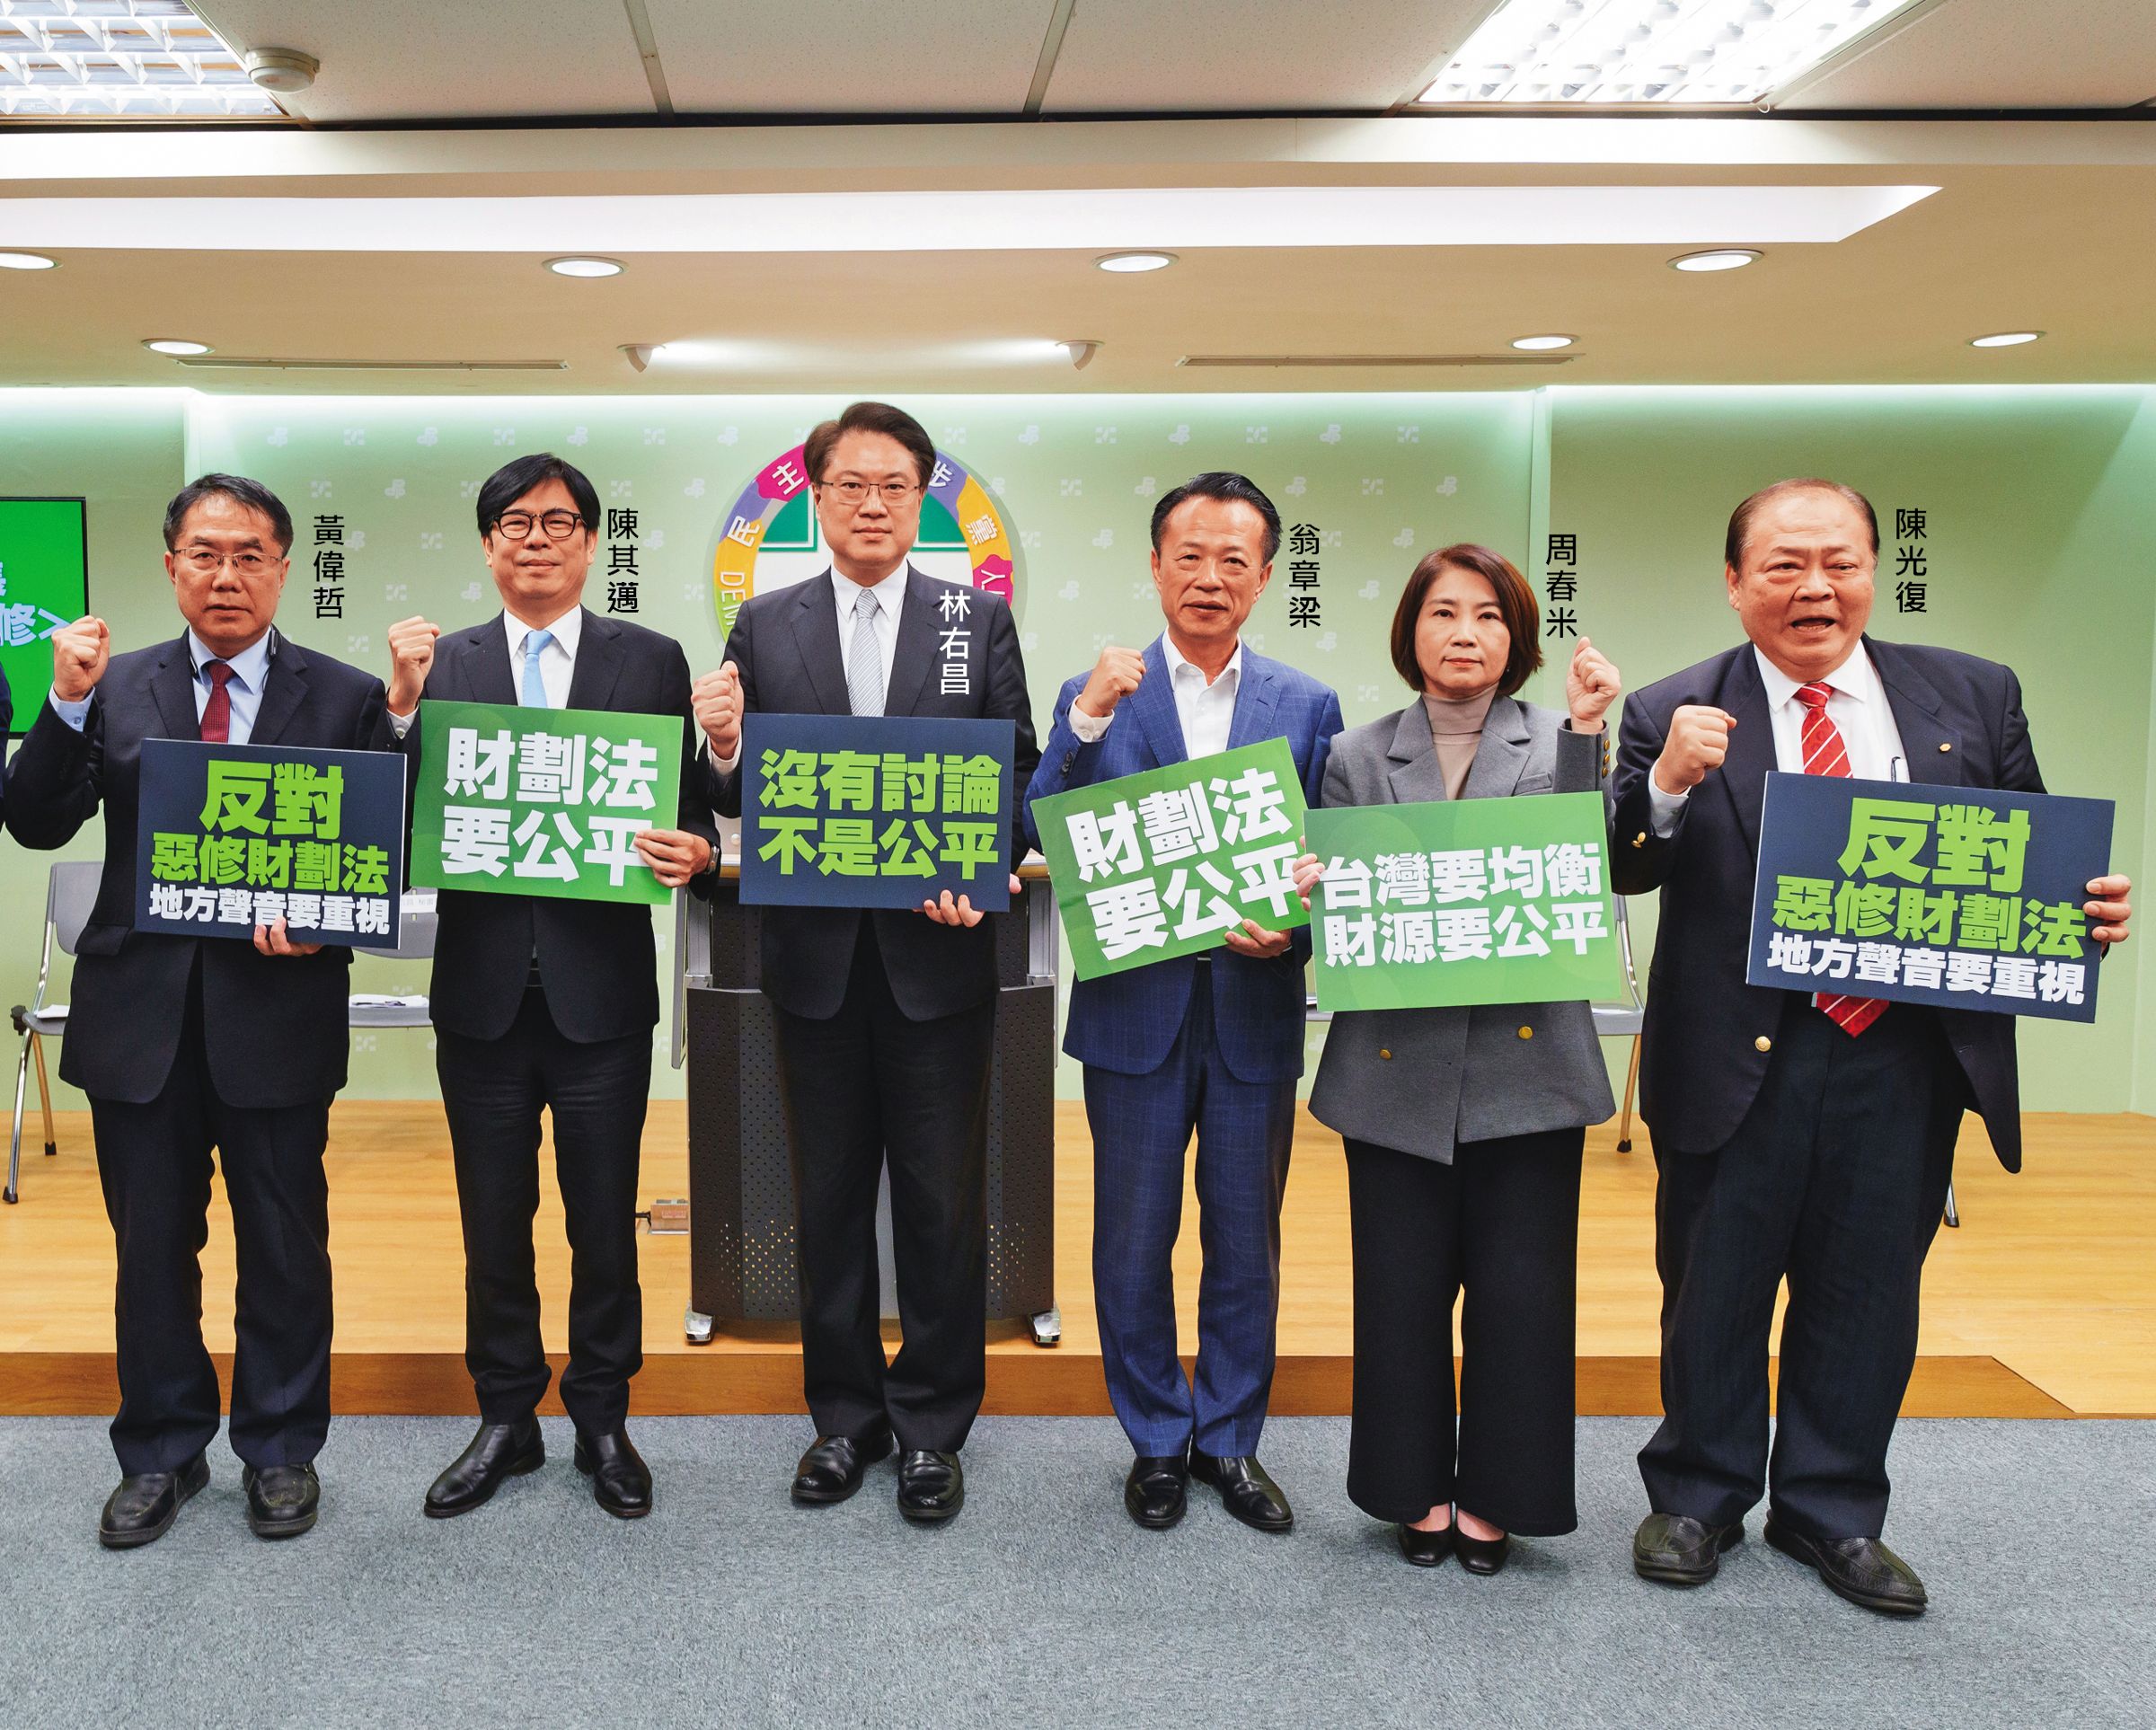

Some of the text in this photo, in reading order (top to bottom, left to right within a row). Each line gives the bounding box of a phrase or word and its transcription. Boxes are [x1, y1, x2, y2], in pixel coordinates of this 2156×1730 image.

[199, 759, 345, 840] 反對
[444, 728, 658, 810] 財劃法
[758, 748, 1003, 815] 沒有討論
[440, 807, 655, 887] 要公平
[757, 816, 999, 880] 不是公平
[1065, 767, 1294, 883] 財劃法
[1838, 798, 2030, 893] 反對
[151, 832, 390, 896] 惡修財劃法
[1085, 841, 1299, 961] 要公平
[1319, 842, 1602, 911] 台灣要均衡
[148, 883, 390, 935] 地方聲音要重視
[1323, 901, 1609, 968] 財源要公平
[1772, 874, 2087, 959] 惡修財劃法
[1766, 932, 2086, 1005] 地方聲音要重視
